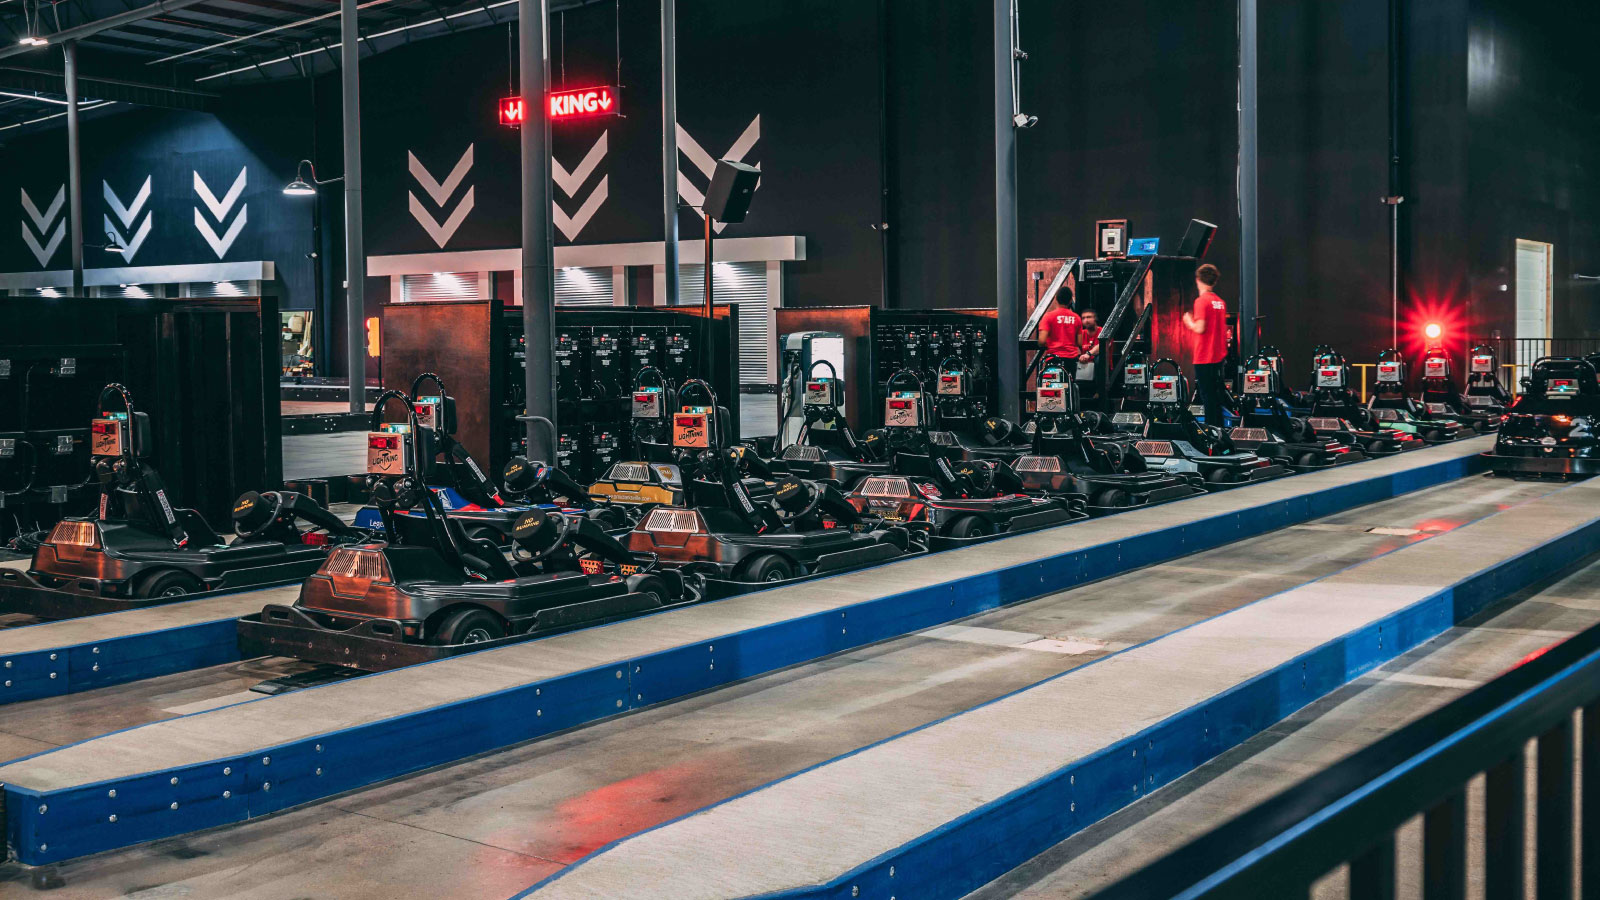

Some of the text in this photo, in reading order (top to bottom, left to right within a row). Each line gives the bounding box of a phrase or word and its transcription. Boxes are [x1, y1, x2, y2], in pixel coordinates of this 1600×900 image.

[1056, 315, 1076, 325] STAFF
[1569, 418, 1594, 438] 2
[678, 430, 703, 441] LIGHTNING
[372, 452, 398, 466] LIGHTNING
[524, 517, 534, 525] NO
